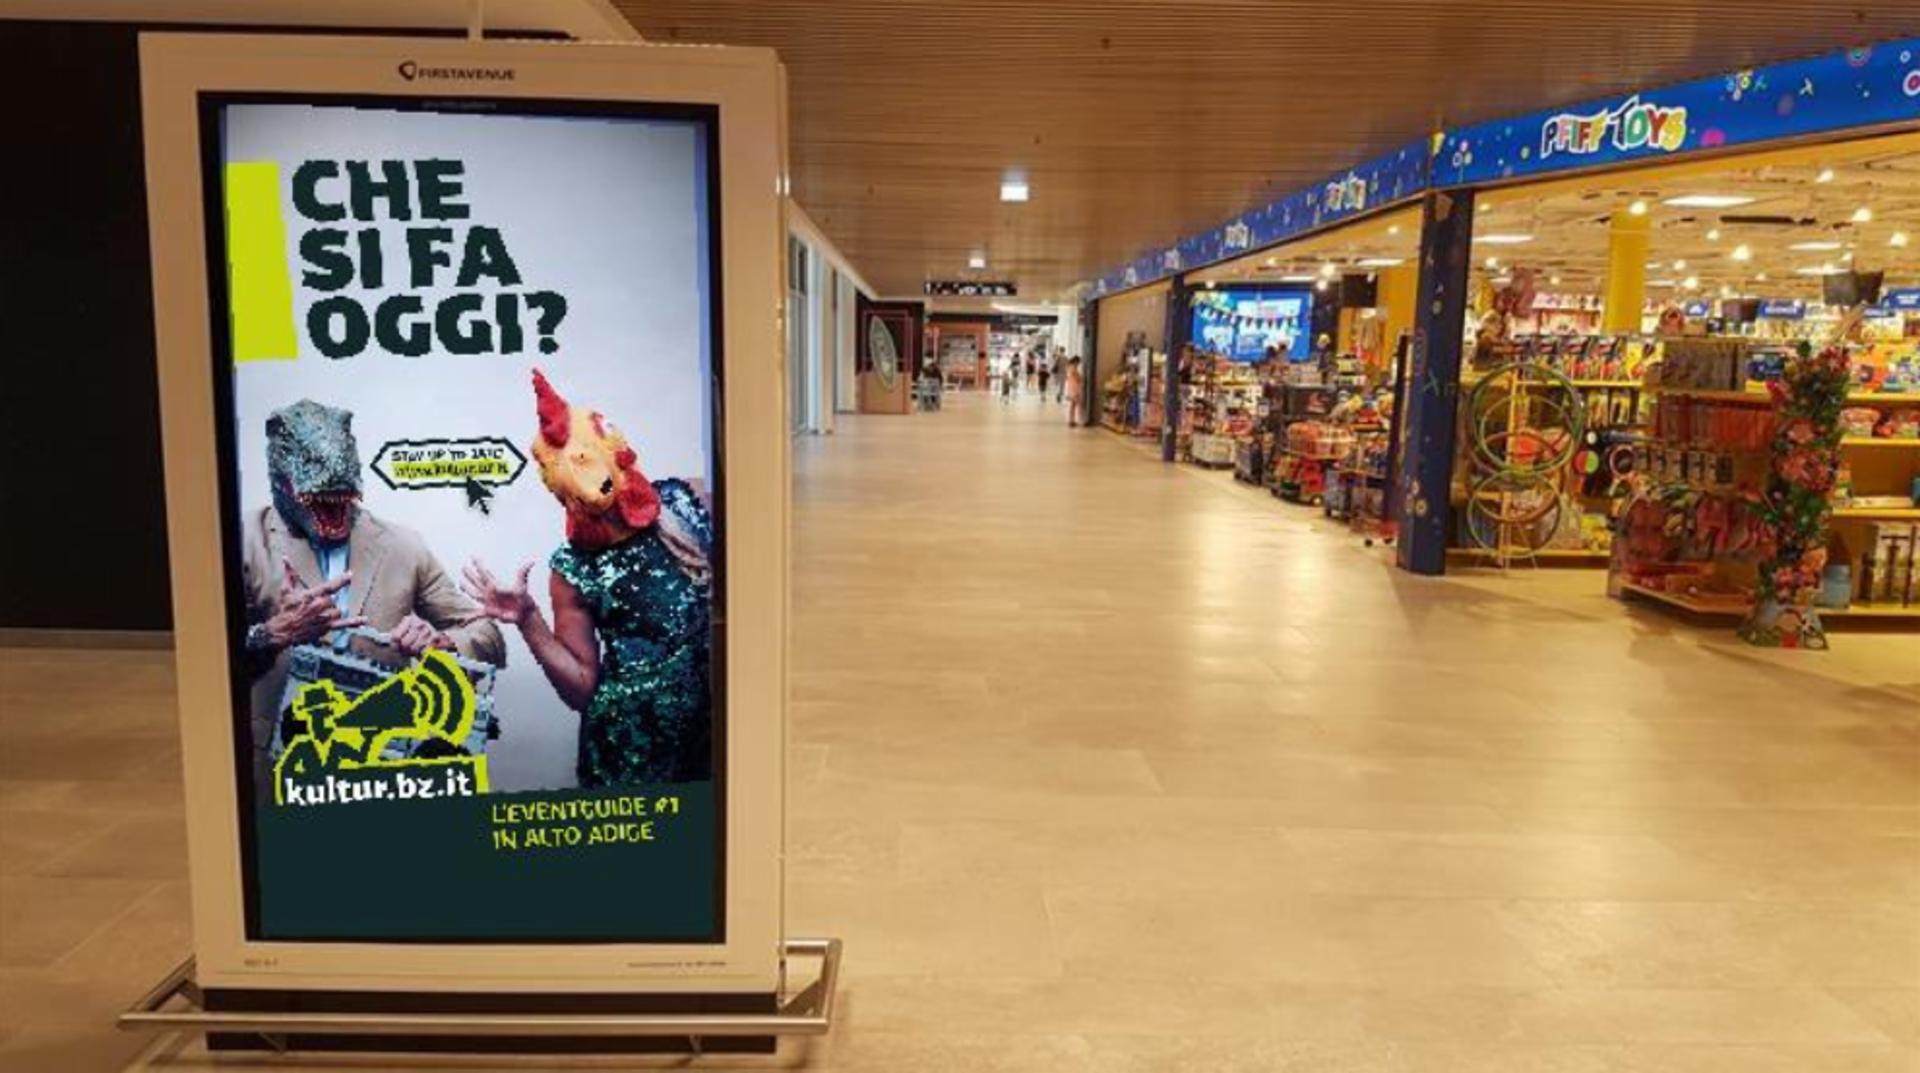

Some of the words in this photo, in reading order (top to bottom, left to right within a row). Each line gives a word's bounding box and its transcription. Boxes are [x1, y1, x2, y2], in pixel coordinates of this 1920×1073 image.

[1540, 107, 1608, 159] PFIFF
[1609, 94, 1687, 151] TOYS
[292, 158, 470, 221] CHE
[299, 228, 383, 291] SI
[406, 225, 523, 288] FA
[307, 290, 567, 359] OGGI?
[284, 768, 473, 806] kultur.bz.it
[493, 829, 517, 850] IN
[524, 826, 582, 848] ALTO
[588, 821, 655, 845] ADIGE
